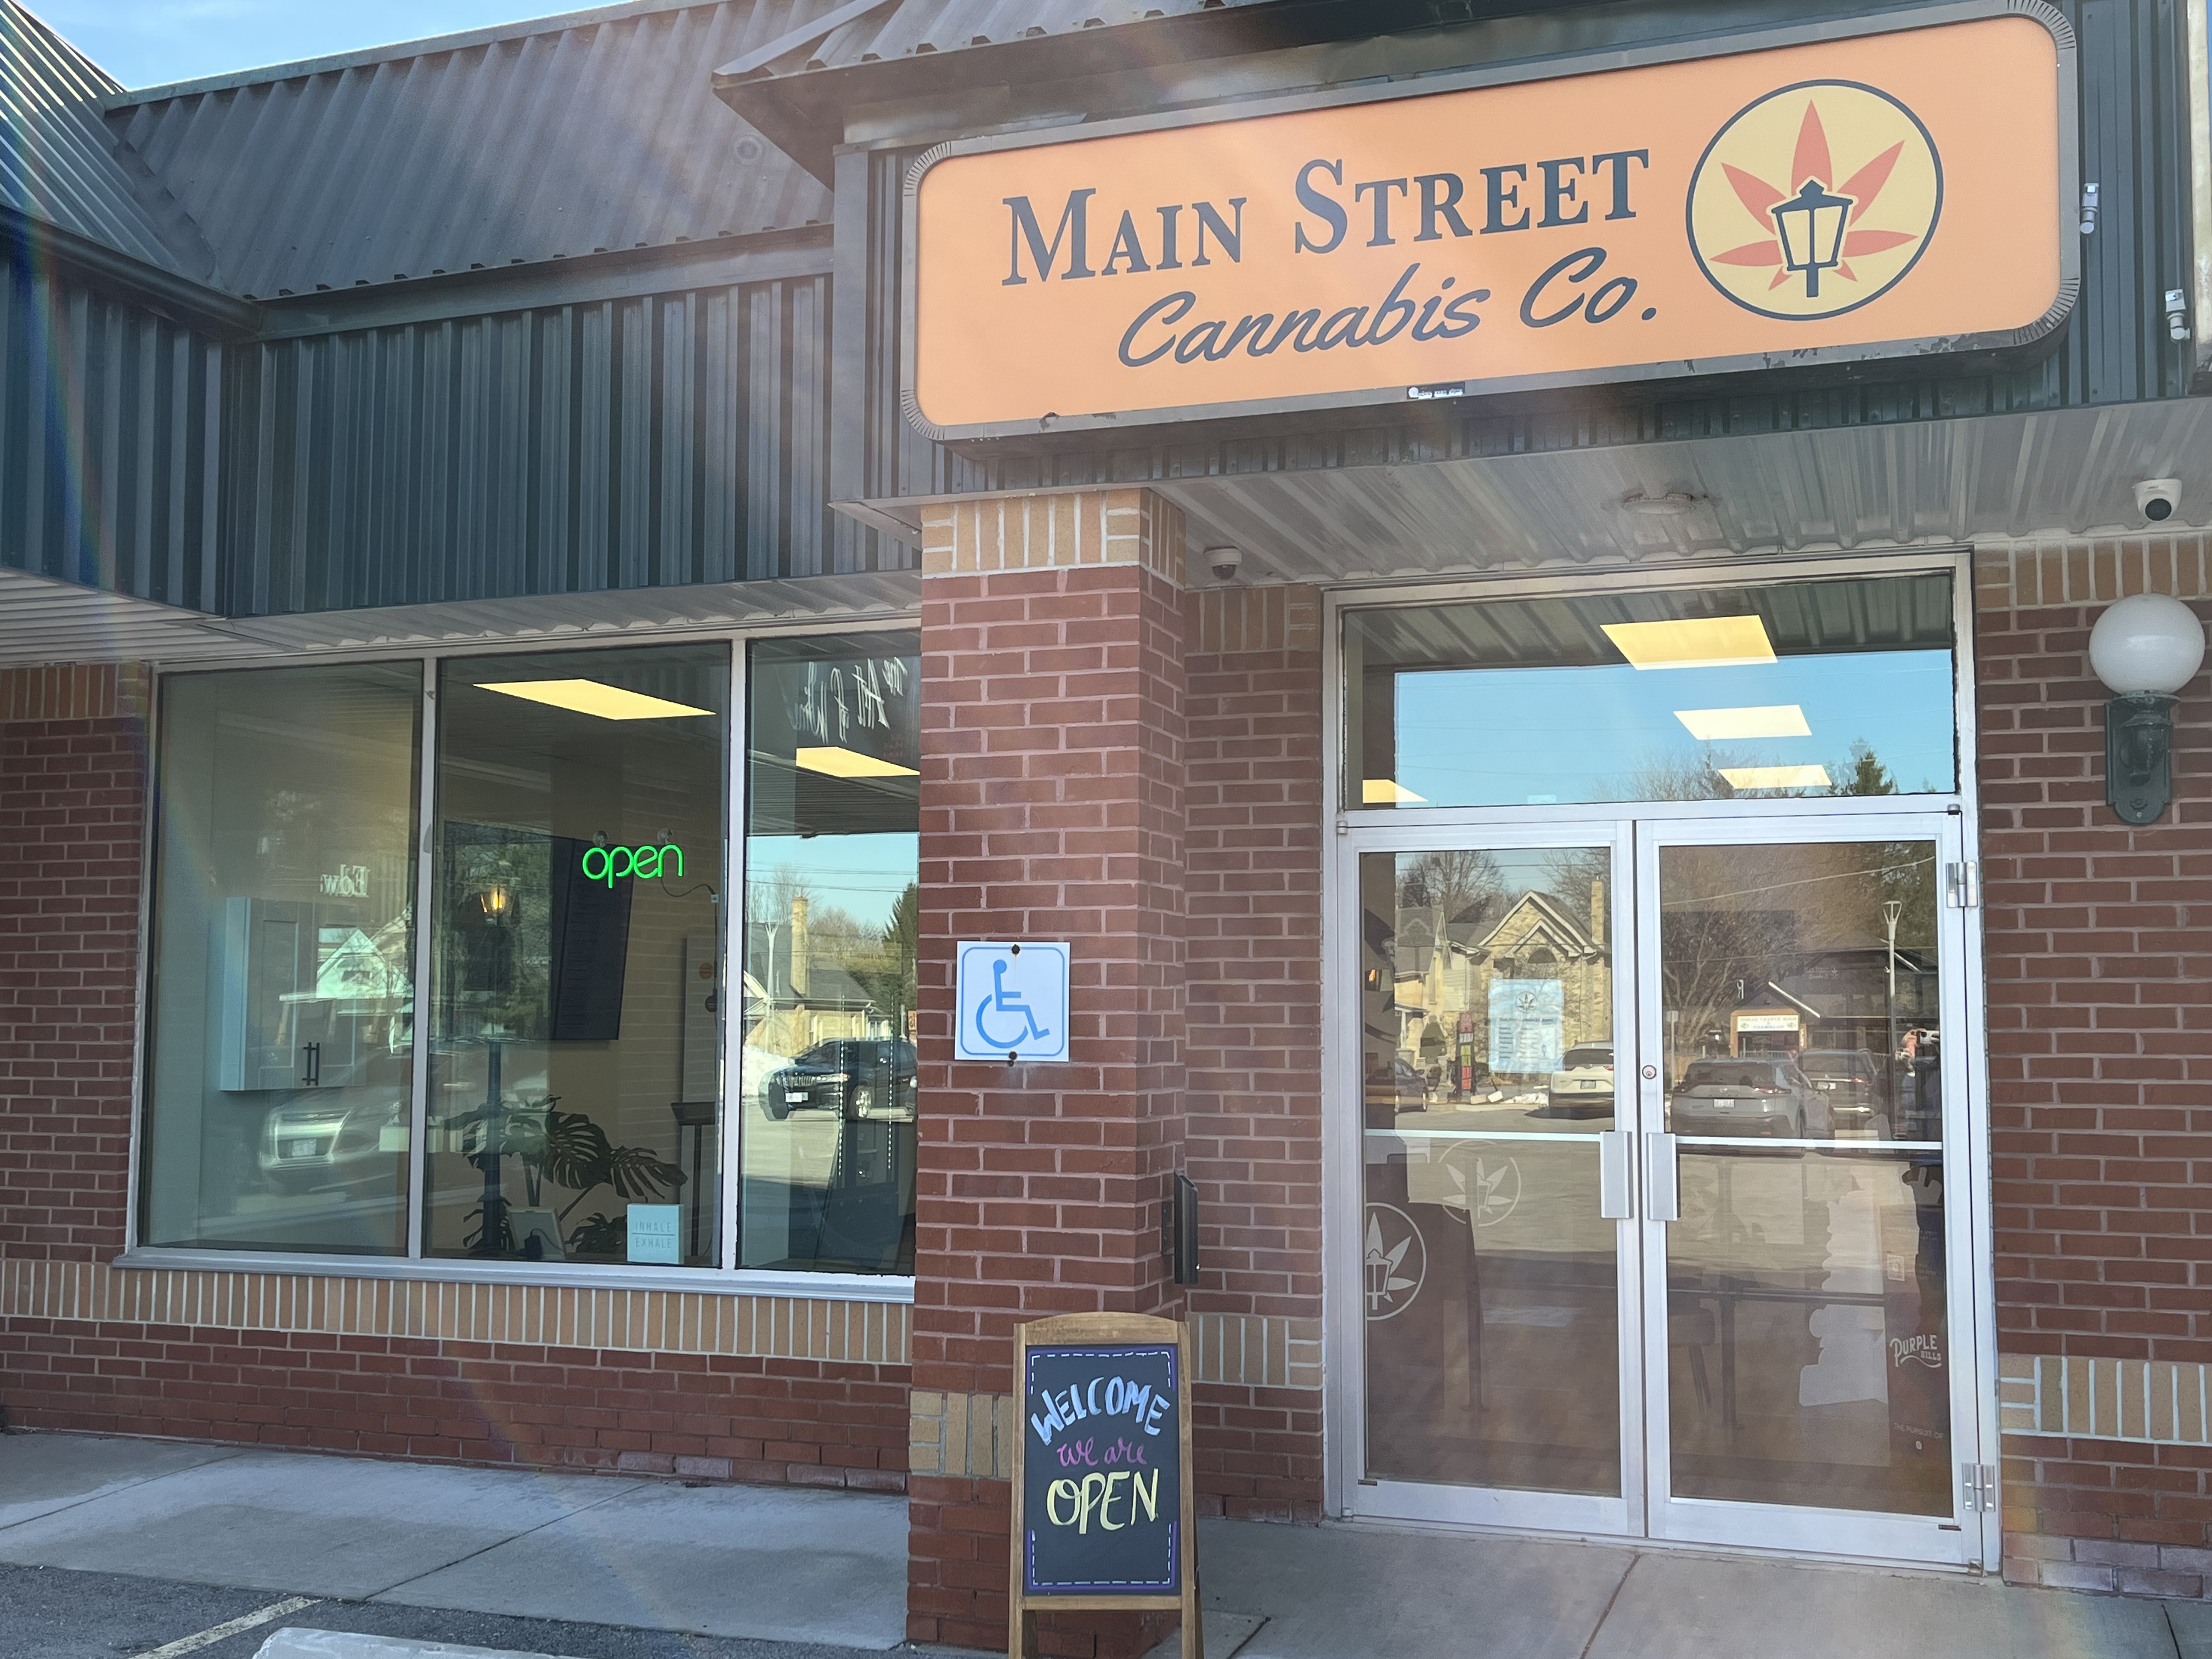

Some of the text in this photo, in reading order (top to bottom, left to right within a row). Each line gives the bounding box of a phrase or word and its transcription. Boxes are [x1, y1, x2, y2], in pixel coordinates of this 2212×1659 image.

[1001, 149, 1650, 286] MAIN STREET
[1118, 247, 1657, 368] Cannabis Co.
[582, 844, 684, 889] open
[635, 1221, 672, 1233] INHALE
[635, 1237, 672, 1249] EXHALE
[1889, 1334, 1938, 1367] PURPLE
[1920, 1350, 1942, 1361] HILLS
[1031, 1376, 1171, 1446] WELCOME
[1057, 1436, 1148, 1467] we are
[1046, 1468, 1159, 1535] OPEN
